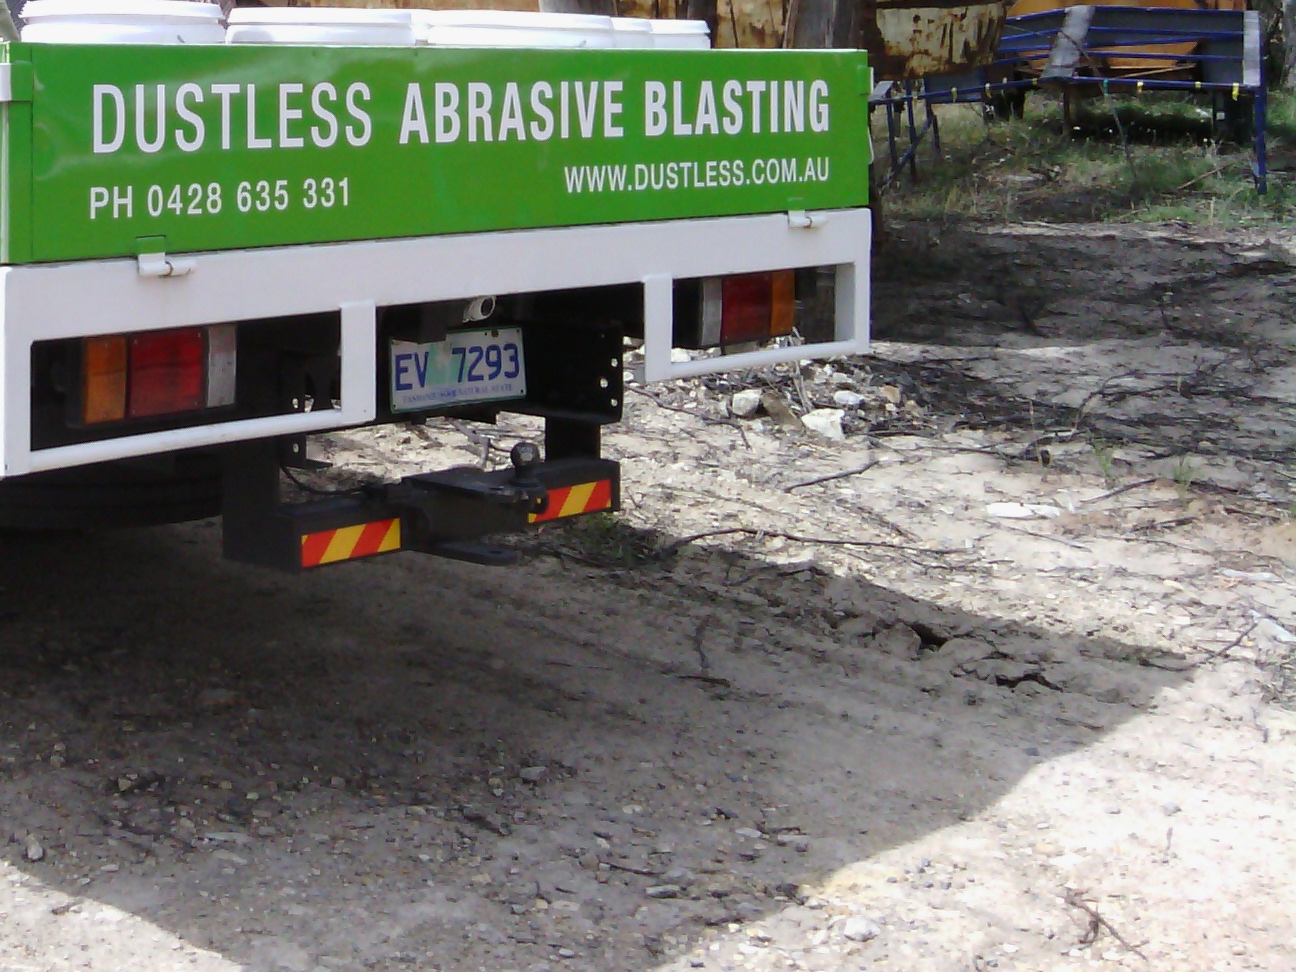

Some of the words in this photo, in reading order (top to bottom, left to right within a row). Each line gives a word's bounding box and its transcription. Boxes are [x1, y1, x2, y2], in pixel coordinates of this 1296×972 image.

[92, 81, 373, 154] DUSTLESS
[398, 80, 625, 145] ABRASIVE
[644, 79, 830, 137] BLASTING
[564, 156, 830, 194] WWW.DUSTLESS.COM.AU
[90, 185, 133, 219] PH
[147, 182, 223, 218] 0428
[236, 180, 289, 213] 635
[302, 177, 350, 209] 331
[395, 351, 430, 391] EV
[452, 342, 520, 383] 7293
